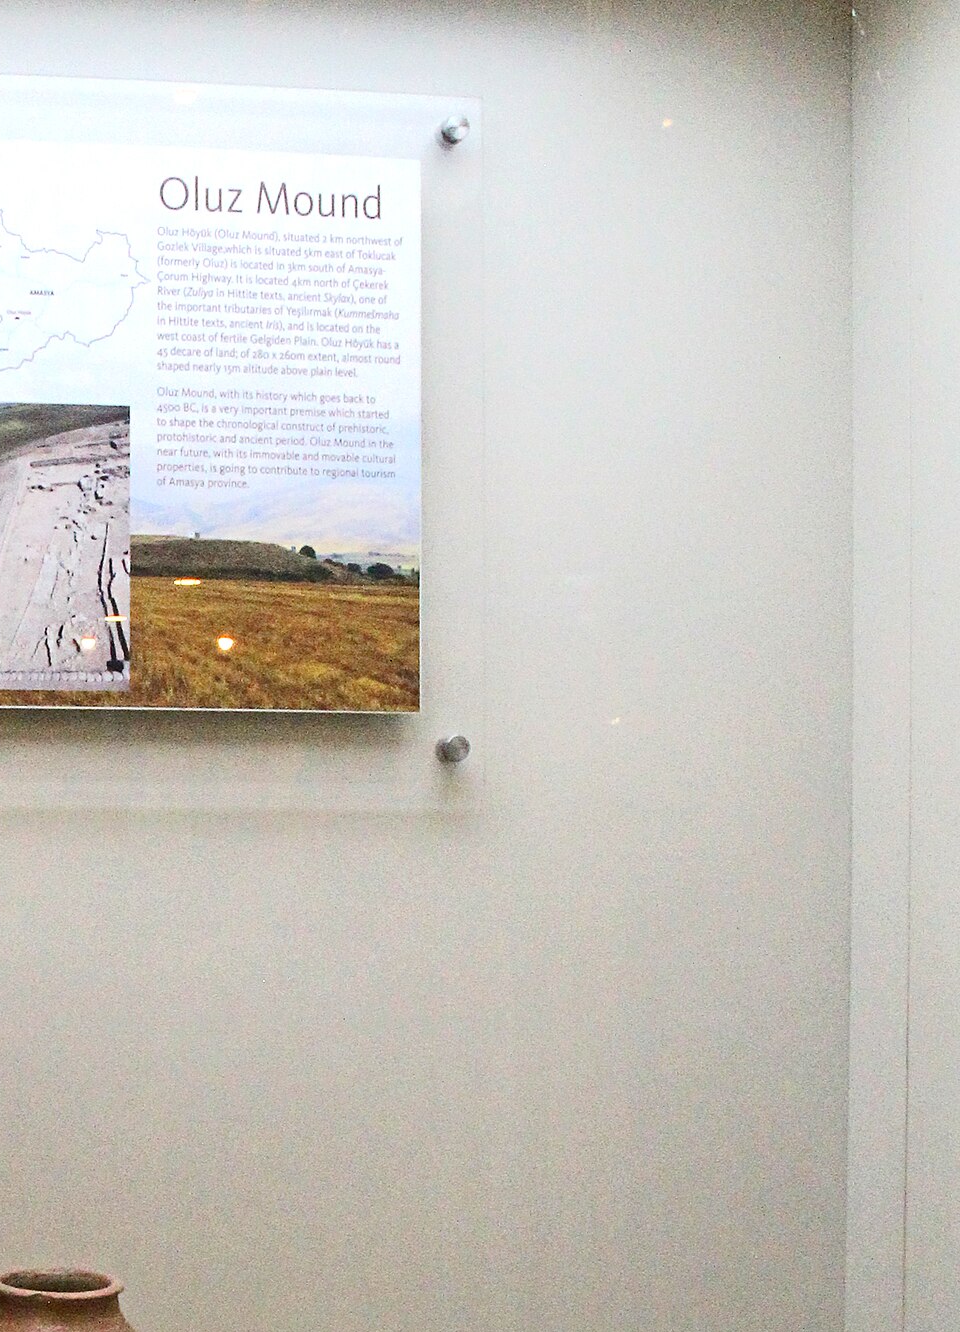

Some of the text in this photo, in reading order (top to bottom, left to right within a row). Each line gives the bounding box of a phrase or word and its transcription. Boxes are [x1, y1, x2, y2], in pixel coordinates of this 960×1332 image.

[159, 175, 382, 220] Oluz Mound
[156, 226, 179, 237] Oluz
[181, 227, 212, 241] Höyük
[214, 228, 240, 241] (Oluz
[282, 231, 320, 243] situated
[329, 233, 344, 244] km
[345, 234, 392, 246] northwest
[393, 236, 403, 247] of
[156, 270, 189, 284] Çorum
[235, 273, 243, 284] It
[245, 274, 253, 285] is
[254, 274, 289, 286] located
[291, 276, 312, 289] 4km
[313, 277, 339, 288] north
[340, 278, 351, 288] of
[352, 278, 389, 292] Çekerek
[156, 332, 179, 342] west
[180, 333, 206, 343] coast
[207, 333, 218, 344] of
[220, 333, 248, 345] fertile
[249, 334, 292, 349] Gelgiden
[320, 337, 343, 348] Oluz
[344, 338, 375, 352] Höyük
[376, 339, 392, 350] has
[393, 342, 400, 350] a
[156, 386, 180, 397] Oluz
[219, 389, 240, 400] with
[242, 389, 254, 400] its
[255, 390, 288, 404] history
[289, 391, 318, 402] which
[319, 395, 341, 406] goes
[342, 393, 364, 404] back
[365, 394, 376, 404] to
[156, 433, 218, 446] protohistoric
[218, 434, 237, 445] and
[238, 435, 273, 446] ancient
[309, 436, 332, 447] Oluz
[333, 437, 366, 448] Mound
[367, 438, 377, 449] in
[378, 438, 395, 449] the
[156, 476, 166, 487] of
[168, 477, 205, 491] Amasya
